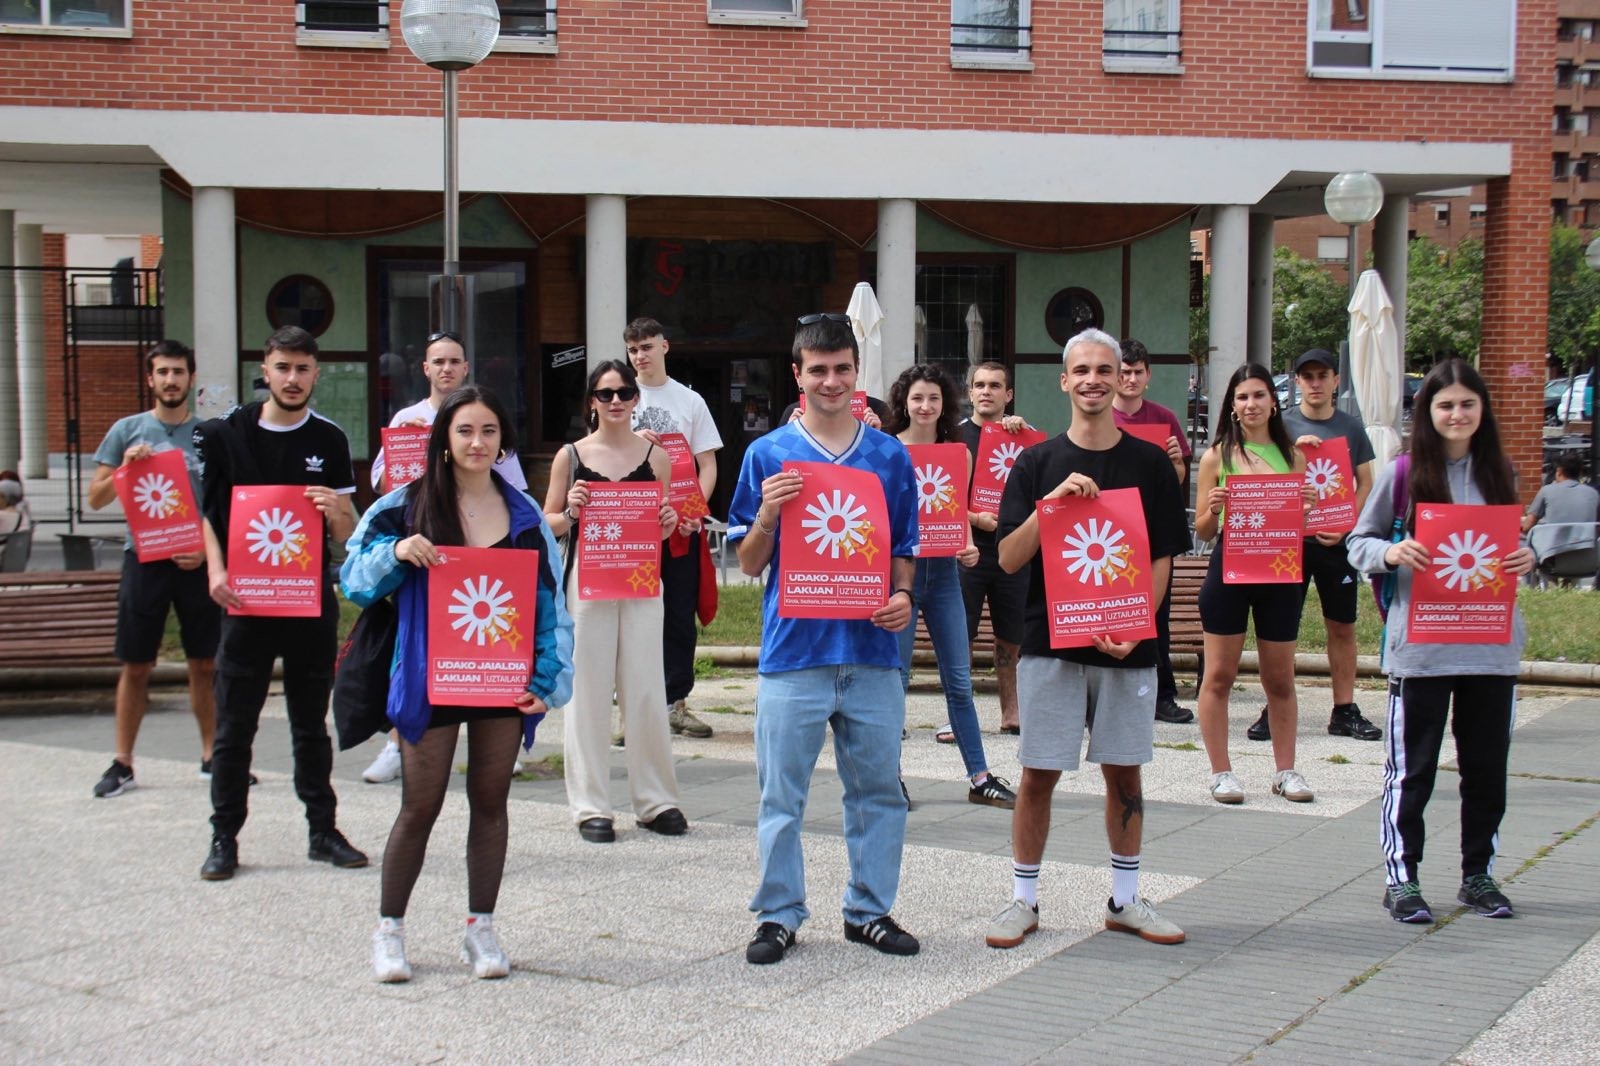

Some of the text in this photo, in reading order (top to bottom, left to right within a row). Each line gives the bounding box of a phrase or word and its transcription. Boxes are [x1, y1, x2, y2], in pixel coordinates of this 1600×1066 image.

[787, 586, 833, 594] LAKUAN
[1057, 596, 1146, 612] UDAKO JAIALDIA
[1056, 614, 1102, 625] LAKUAN
[1107, 610, 1140, 620] UZTAILAK
[437, 661, 526, 670] UDAKO JAIALDIA
[435, 674, 481, 682] LAKUAN
